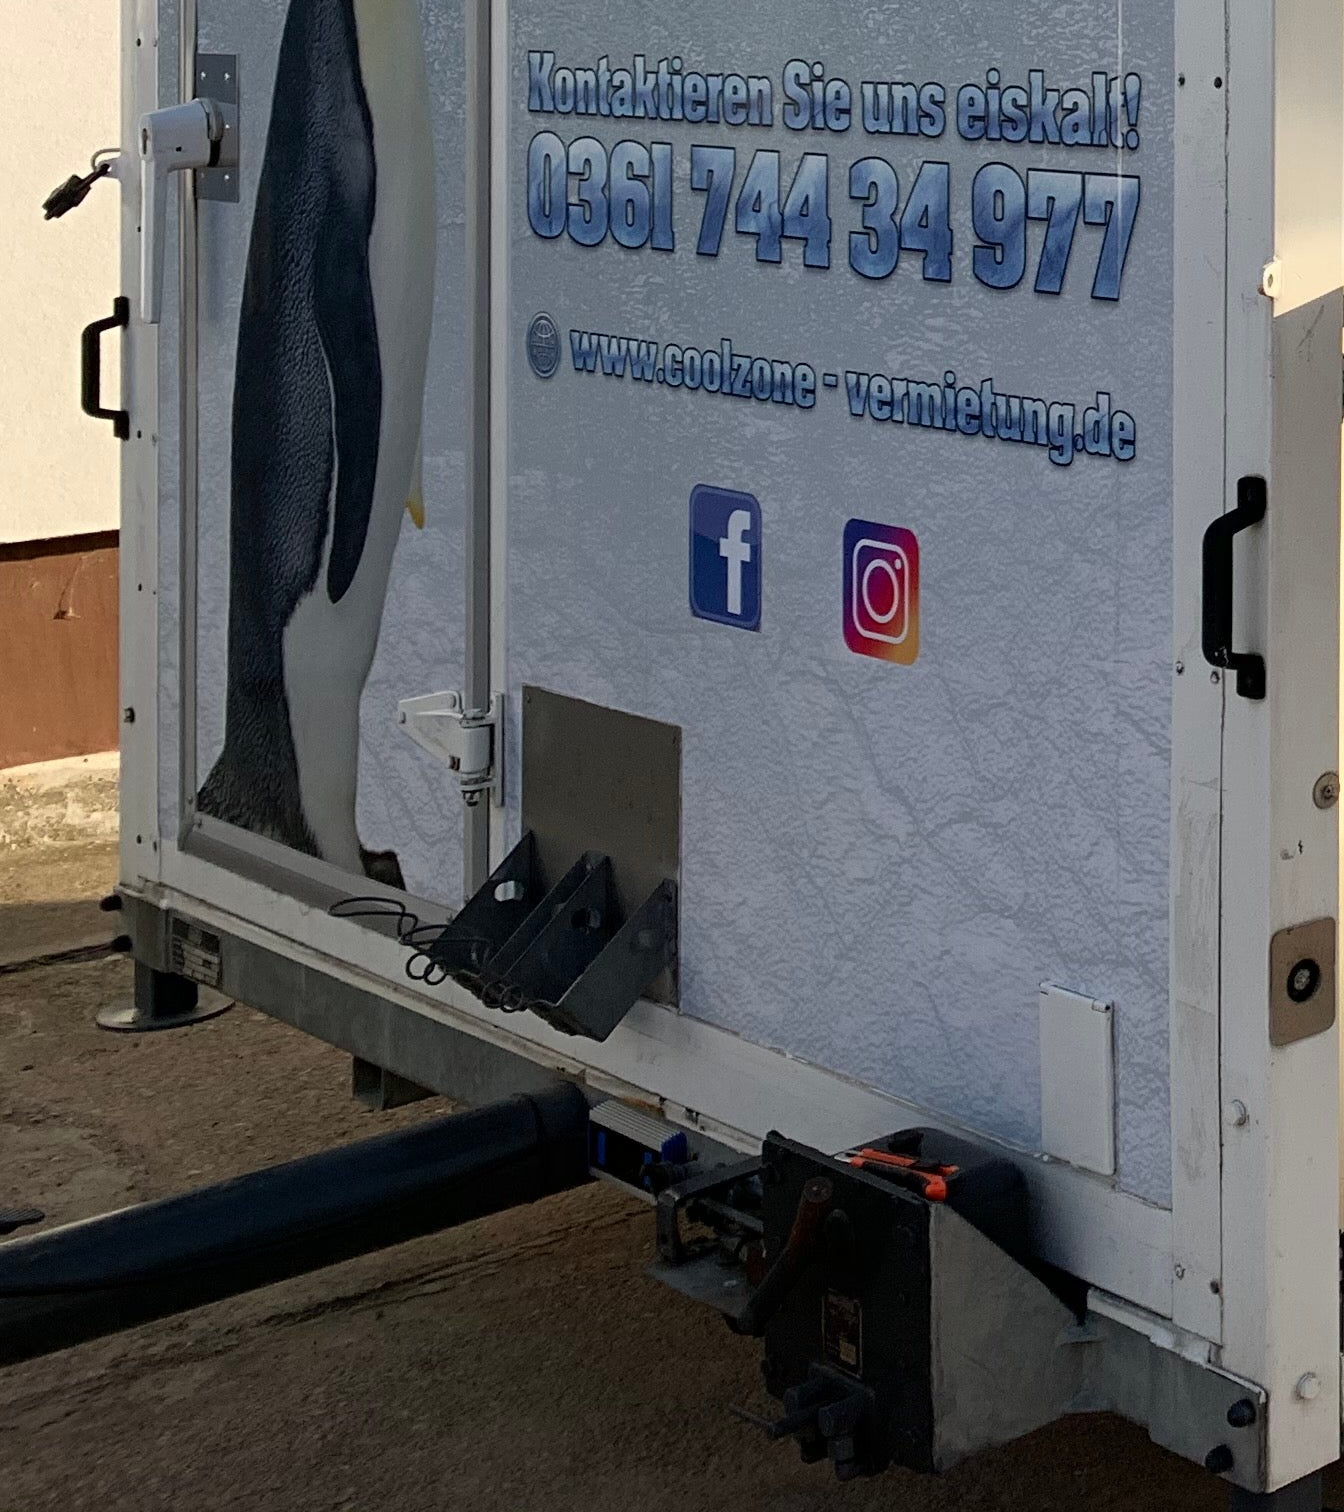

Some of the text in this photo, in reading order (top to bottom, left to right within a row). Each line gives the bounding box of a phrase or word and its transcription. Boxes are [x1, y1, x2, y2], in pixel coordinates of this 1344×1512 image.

[528, 50, 1141, 150] Kontaktieren Sie uns eiskalt!
[527, 131, 1140, 300] 0361 744 34 977
